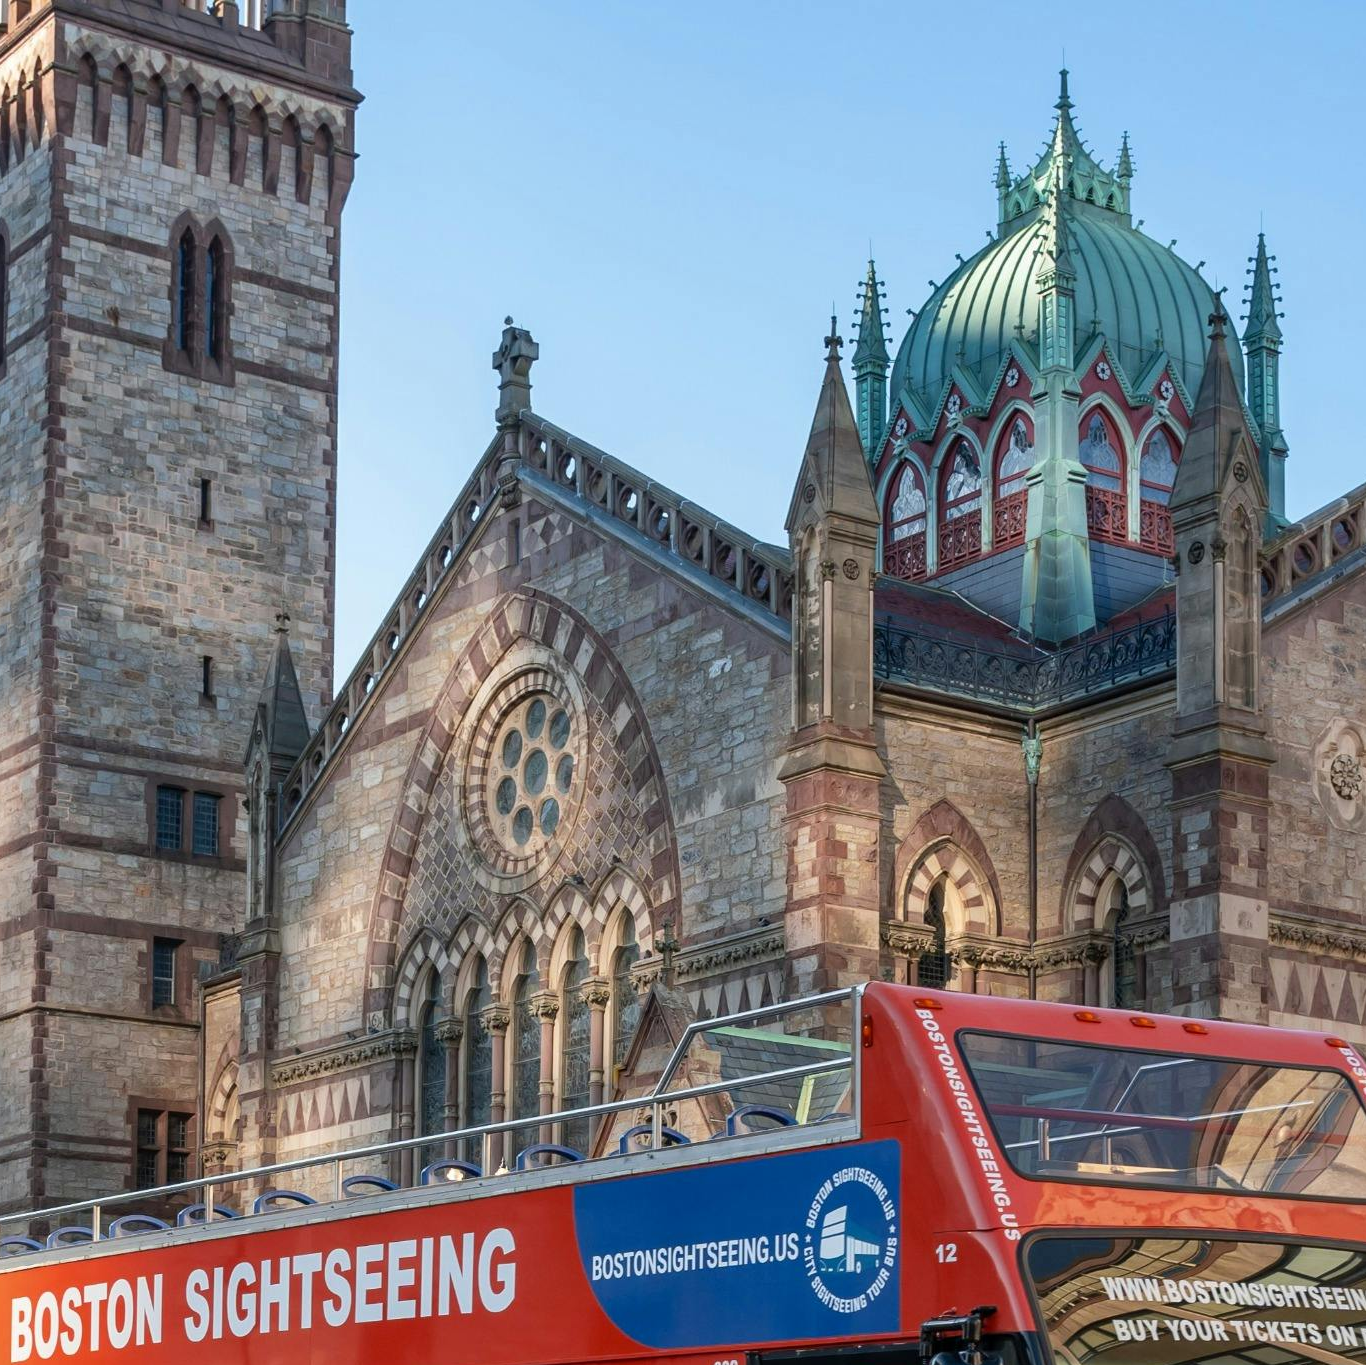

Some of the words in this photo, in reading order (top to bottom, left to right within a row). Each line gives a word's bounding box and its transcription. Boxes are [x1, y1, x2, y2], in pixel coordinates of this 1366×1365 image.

[915, 1008, 1022, 1241] BOSTONSIGHTSEEING.US
[806, 1179, 834, 1229] BOSTON
[832, 1167, 896, 1221] SIGHTSEEING.US
[592, 1233, 799, 1281] BOSTONSIGHTSEEING.US
[804, 1246, 818, 1277] CITY
[811, 1275, 868, 1313] SIGHTSEEING
[866, 1268, 891, 1301] TOUR
[884, 1237, 898, 1267] BUS
[936, 1243, 958, 1264] 12
[10, 1274, 163, 1363] BOSTON
[184, 1228, 517, 1342] SIGHTSEEING
[1112, 1319, 1160, 1342] BUY
[1164, 1319, 1230, 1342] YOUR
[1230, 1320, 1322, 1344] TICKETS
[1327, 1325, 1358, 1347] ON
